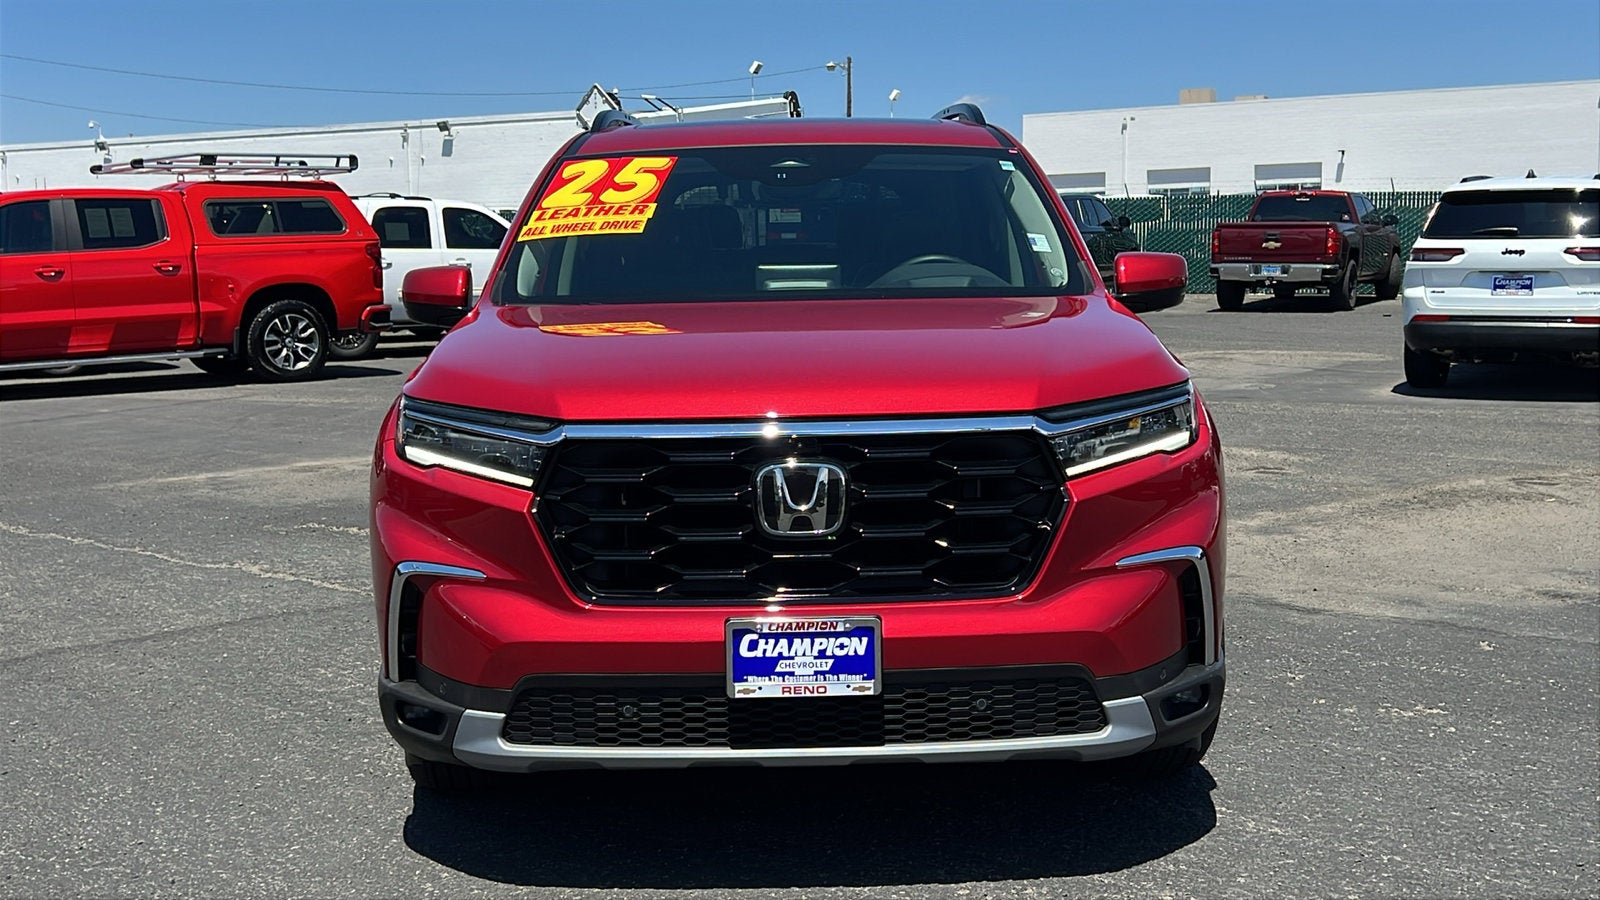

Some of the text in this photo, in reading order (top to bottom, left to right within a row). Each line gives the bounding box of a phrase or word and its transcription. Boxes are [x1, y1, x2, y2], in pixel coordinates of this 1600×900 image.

[541, 157, 673, 208] 25
[534, 204, 650, 222] LEATHER
[521, 219, 641, 238] ALL WHEEL DRIVE
[1501, 247, 1525, 257] Jeep
[768, 621, 838, 631] CHAMPION
[739, 633, 868, 658] CHAMPION
[779, 661, 829, 669] CHEVROLET
[770, 675, 783, 683] The
[784, 674, 816, 683] Customer
[825, 673, 838, 682] The
[781, 685, 827, 695] RENO
